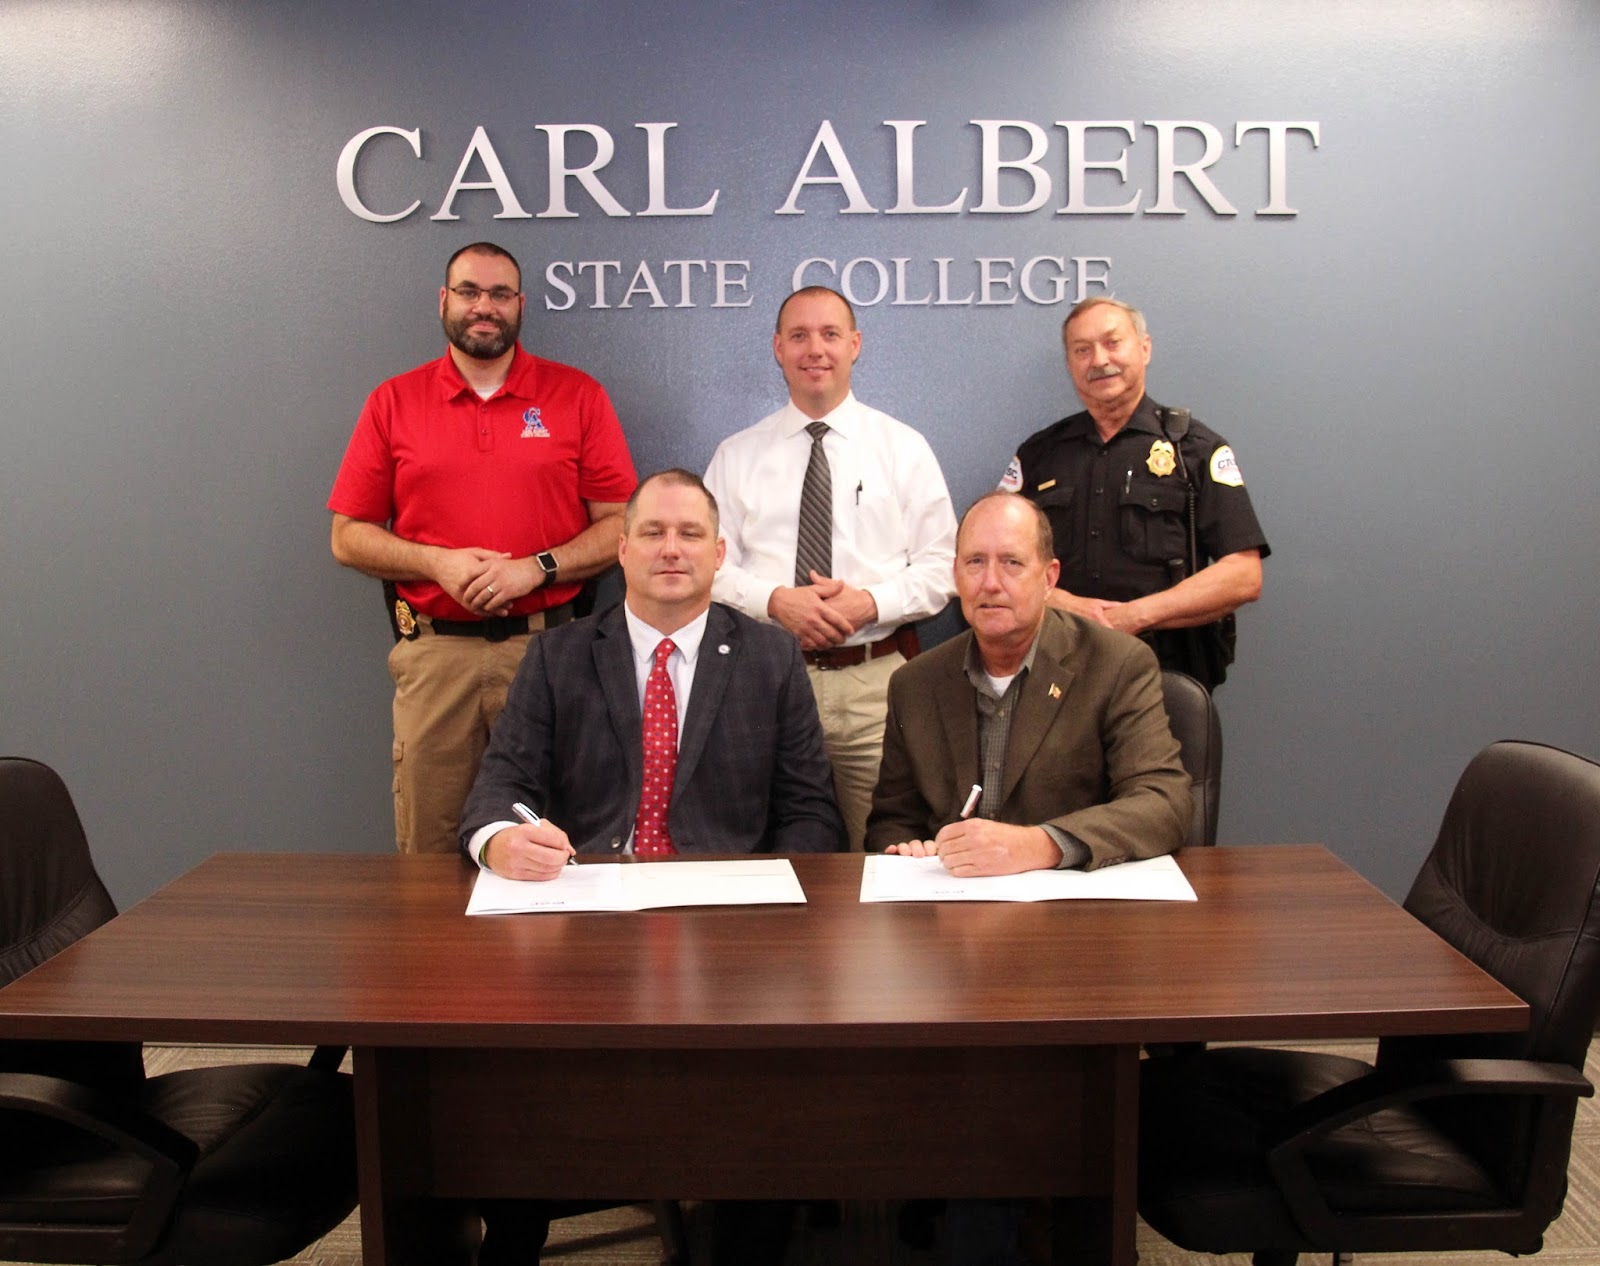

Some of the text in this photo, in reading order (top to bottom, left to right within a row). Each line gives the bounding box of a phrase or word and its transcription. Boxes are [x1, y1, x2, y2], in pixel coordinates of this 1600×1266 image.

[336, 119, 1321, 223] CARL ALBERT
[544, 259, 754, 311] STATE
